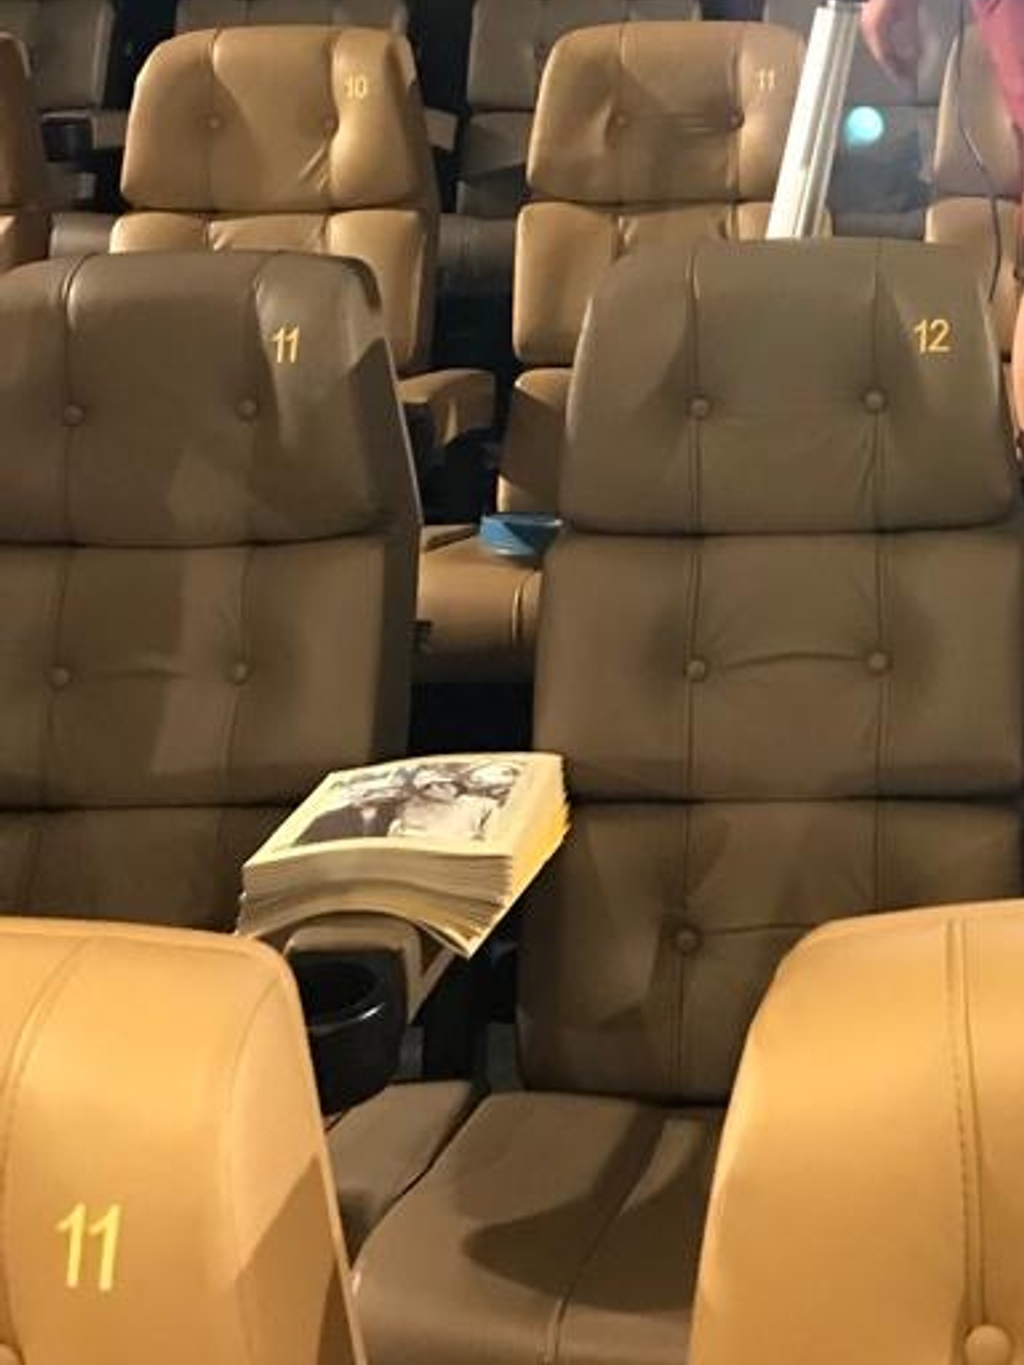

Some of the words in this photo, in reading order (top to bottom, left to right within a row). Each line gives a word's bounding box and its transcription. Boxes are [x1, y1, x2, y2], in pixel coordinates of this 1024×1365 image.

[343, 73, 369, 100] 10
[756, 68, 775, 92] 11
[270, 324, 300, 364] 11
[913, 318, 951, 354] 12
[56, 1201, 121, 1293] 11
